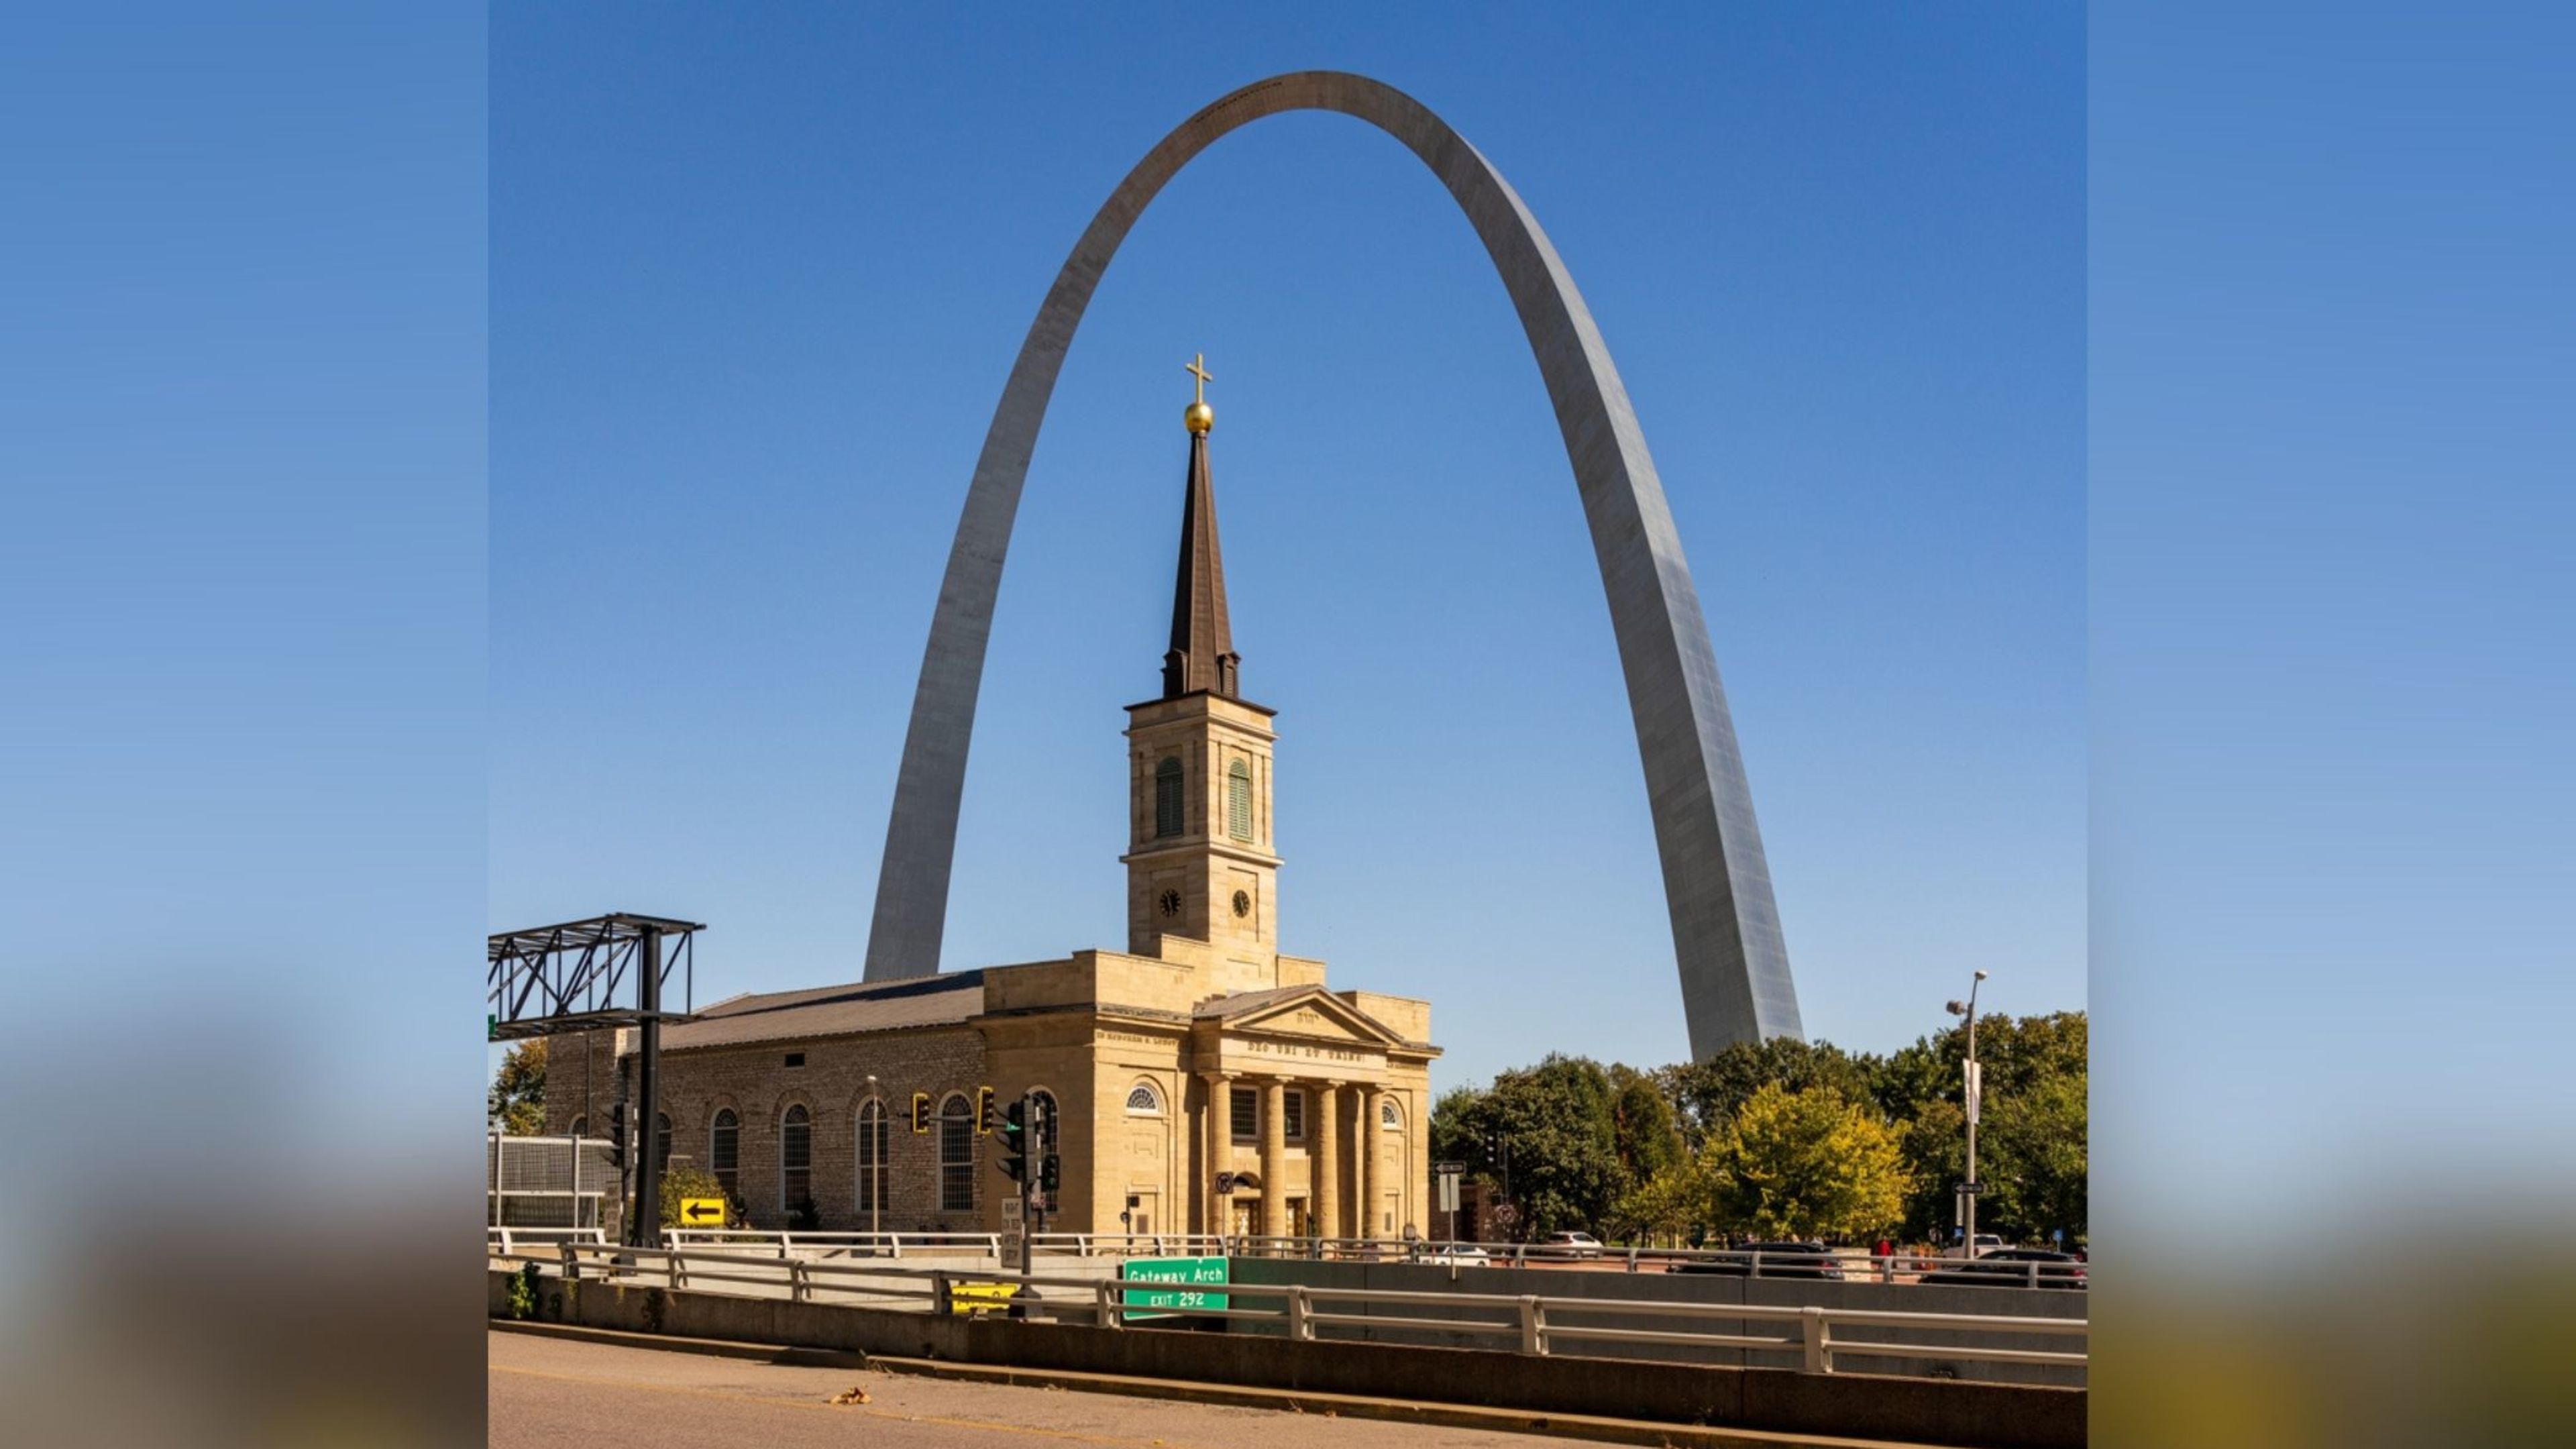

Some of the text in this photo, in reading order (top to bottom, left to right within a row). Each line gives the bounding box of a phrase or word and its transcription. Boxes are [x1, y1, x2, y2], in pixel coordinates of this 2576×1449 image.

[1130, 1267, 1223, 1283] Gateway Arch
[1150, 1292, 1205, 1307] EXIT 292
